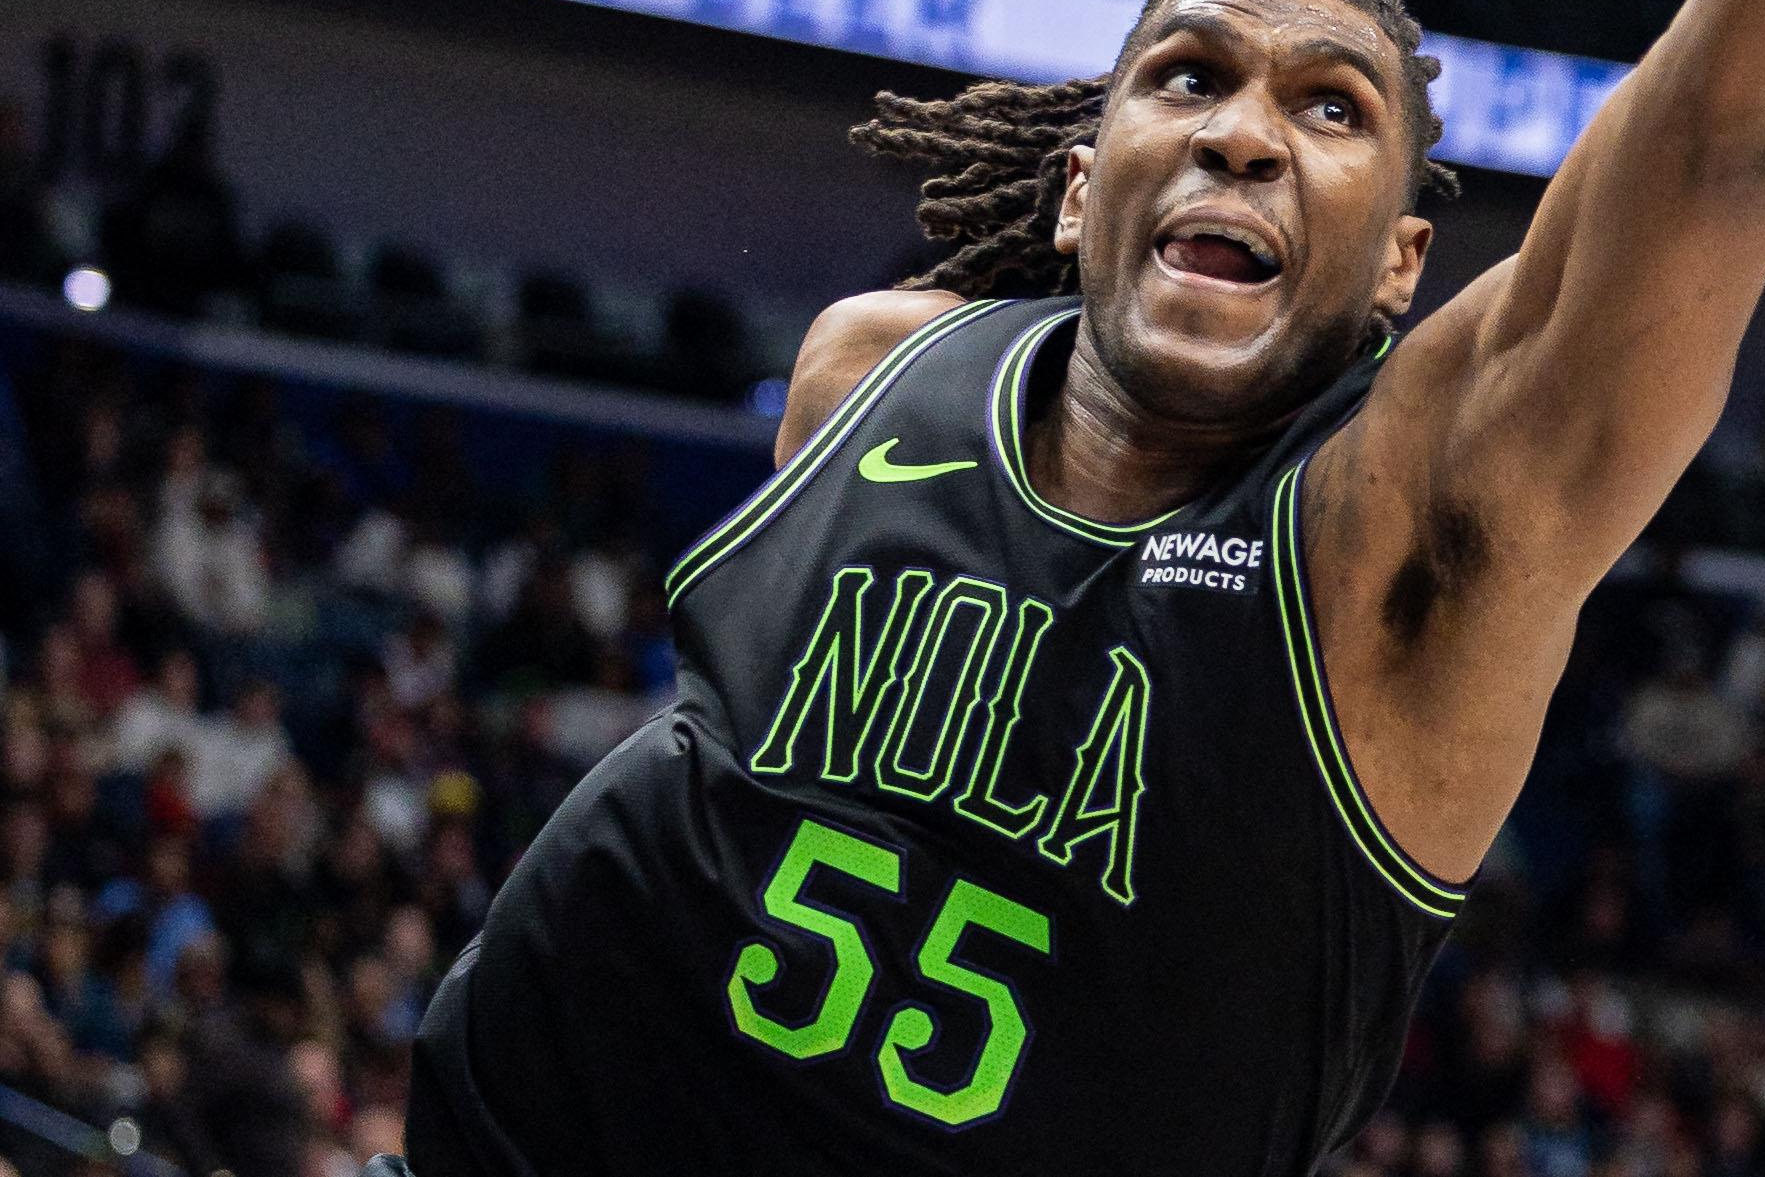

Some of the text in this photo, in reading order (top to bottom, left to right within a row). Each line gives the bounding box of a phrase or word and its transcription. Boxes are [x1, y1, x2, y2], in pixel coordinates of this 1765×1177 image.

[1140, 532, 1264, 568] NEWAGE
[1141, 566, 1246, 591] PRODUCTS
[750, 566, 1151, 906] NOLA
[727, 817, 1055, 1130] 55
